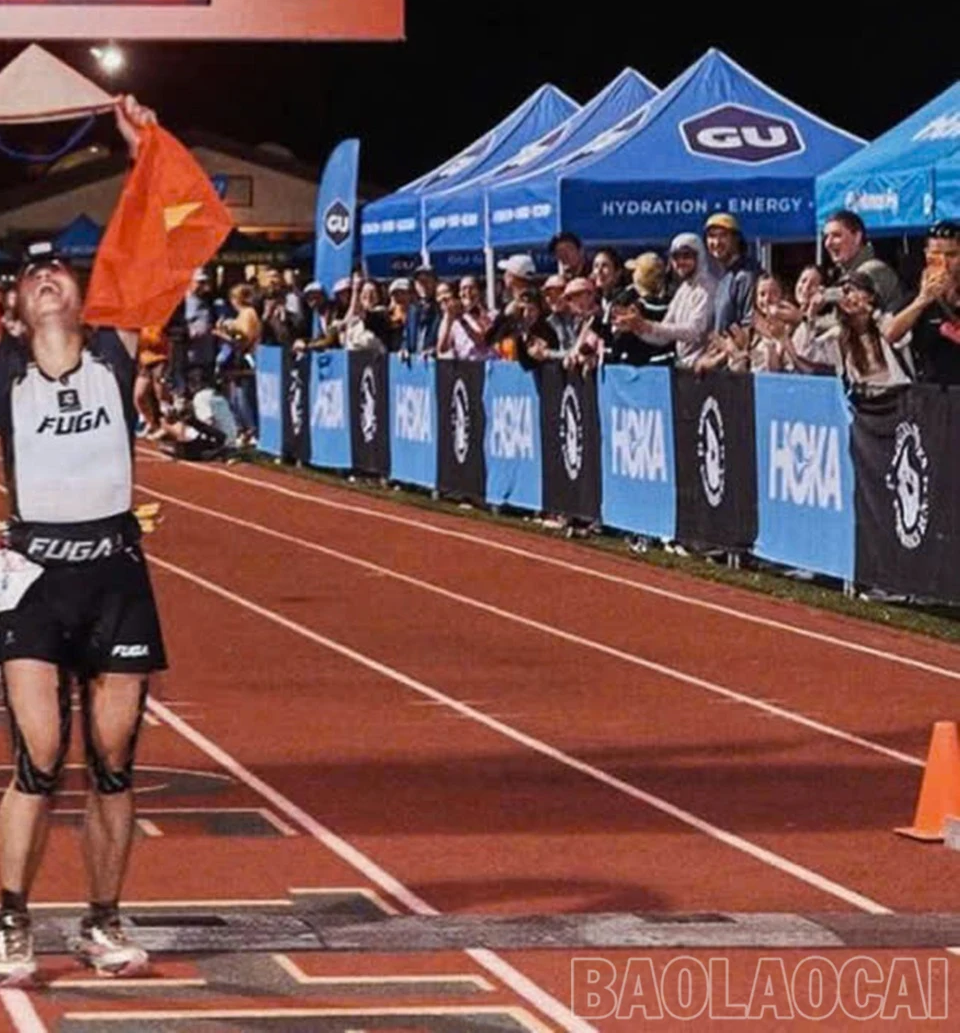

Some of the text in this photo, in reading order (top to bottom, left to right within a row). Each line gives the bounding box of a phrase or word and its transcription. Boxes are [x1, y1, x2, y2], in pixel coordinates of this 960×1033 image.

[696, 125, 789, 149] GU
[602, 197, 803, 216] HYDRATION ENERGY
[326, 215, 349, 234] GU
[36, 406, 111, 435] FUGA
[395, 384, 434, 443] HOKA
[491, 395, 535, 460] HOKA
[611, 405, 669, 484] HOKA
[768, 419, 843, 512] HOKA
[28, 537, 112, 562] FUGA
[111, 644, 149, 658] FUGA
